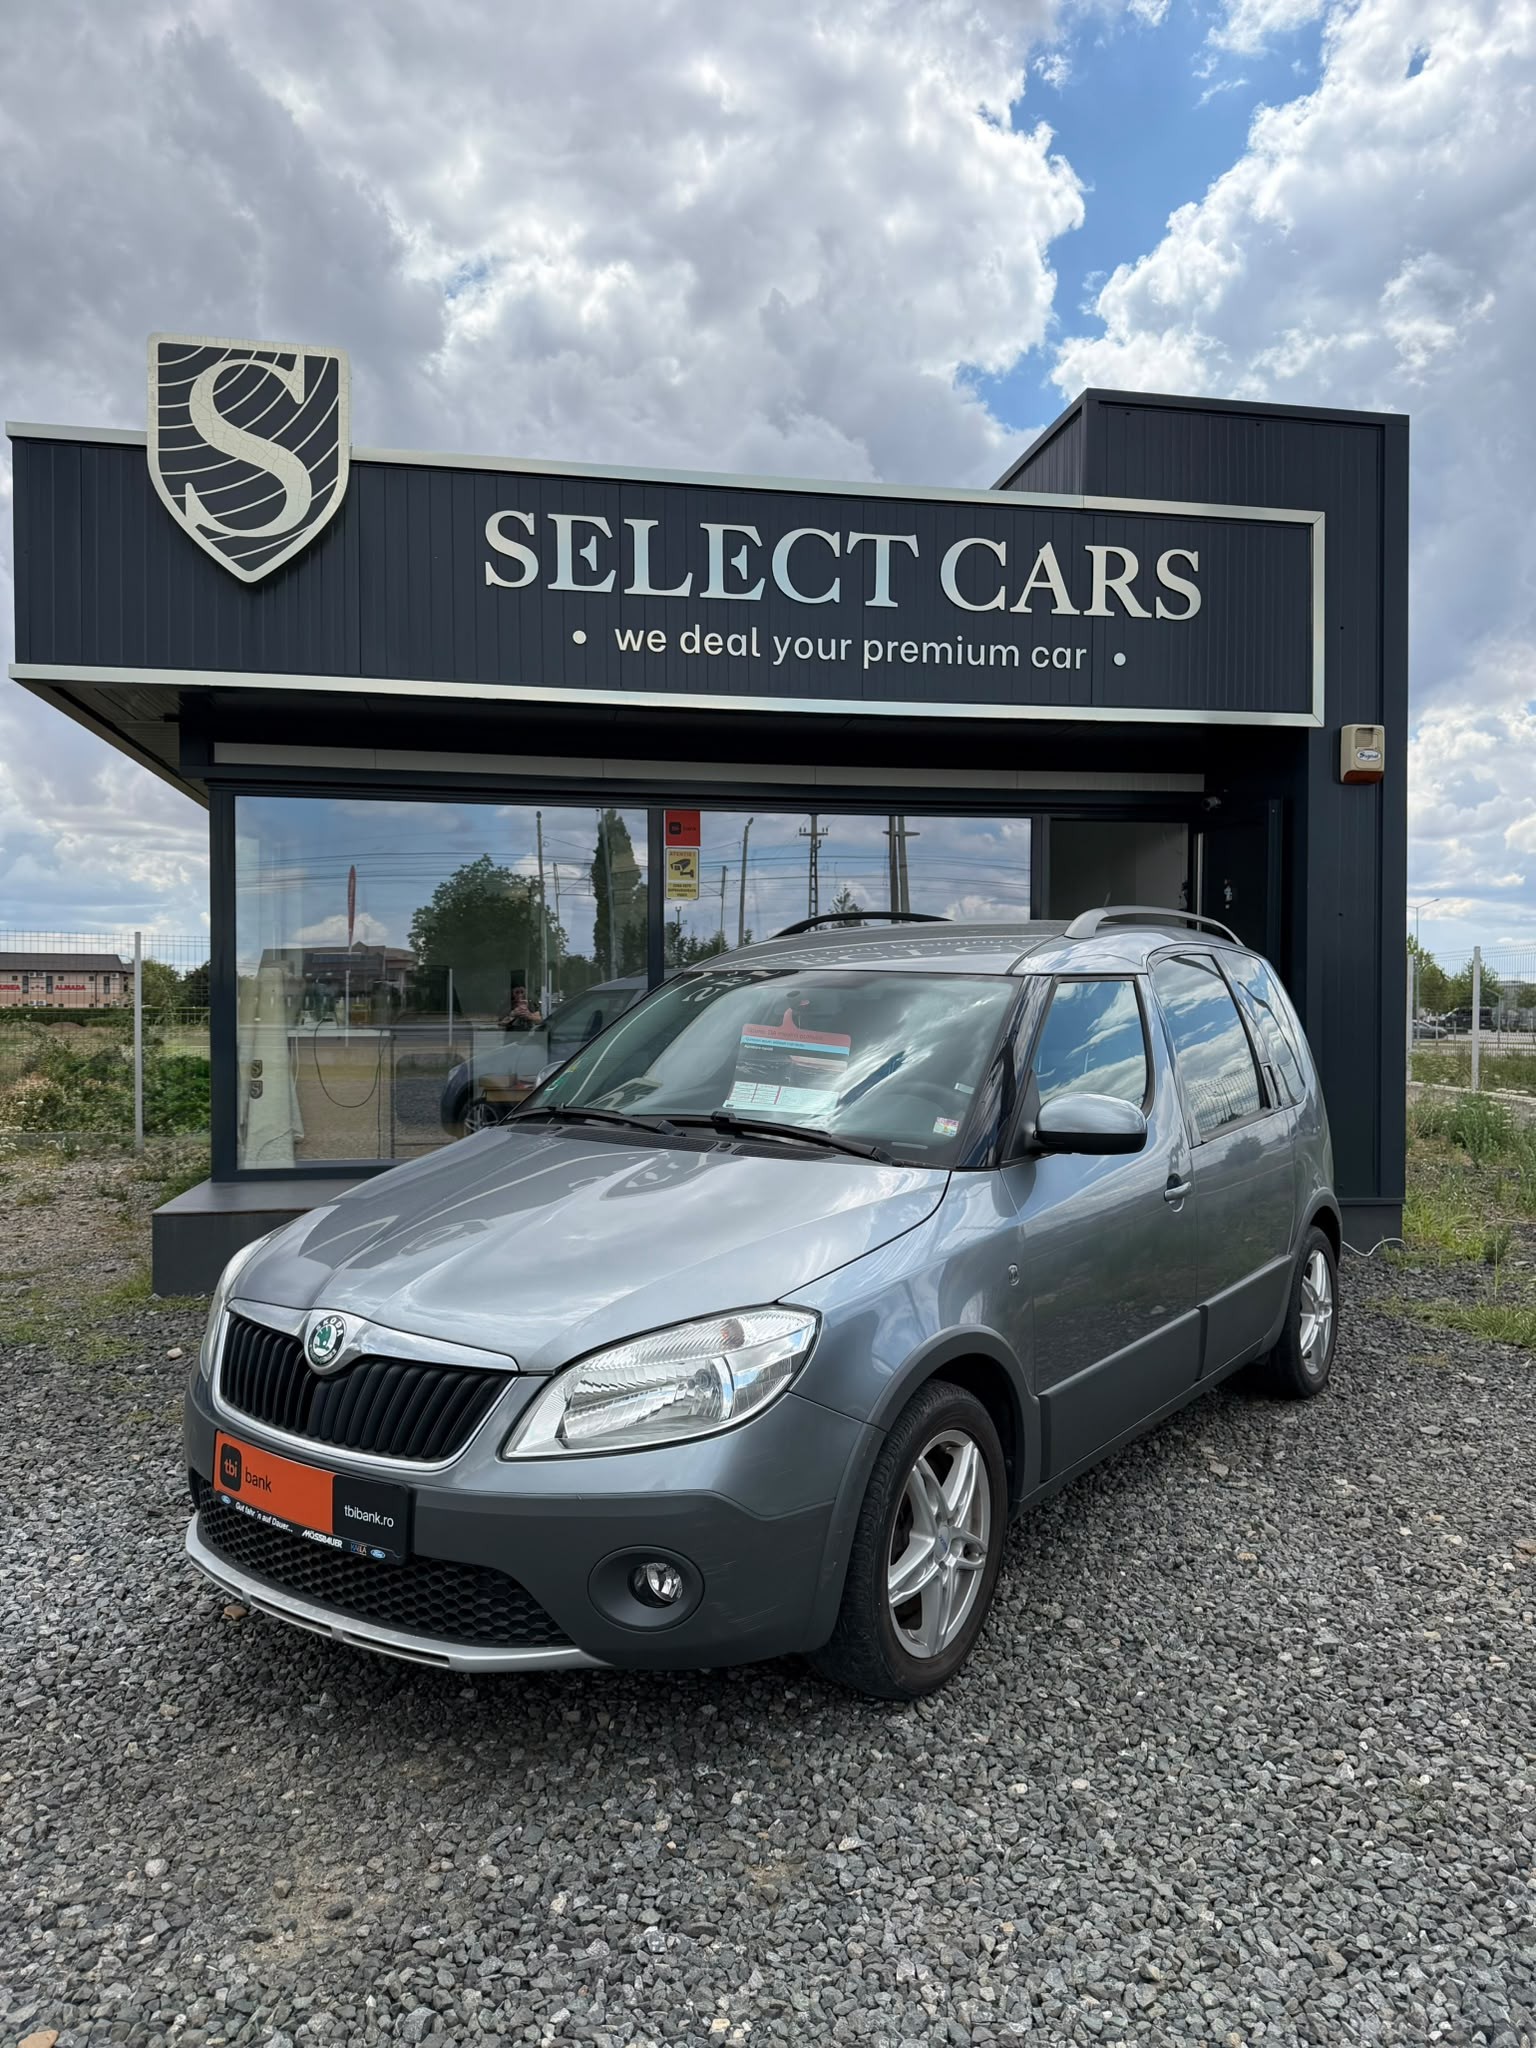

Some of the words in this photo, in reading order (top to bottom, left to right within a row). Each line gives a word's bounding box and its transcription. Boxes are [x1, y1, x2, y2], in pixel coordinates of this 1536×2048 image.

[185, 353, 312, 539] S
[484, 509, 920, 608] SELECT
[940, 537, 1202, 621] CARS
[614, 628, 667, 653] we
[679, 624, 761, 658] deal
[772, 635, 852, 666] your
[863, 635, 1020, 669] premium
[1031, 646, 1087, 670] car
[224, 1458, 238, 1478] tbi
[245, 1466, 272, 1493] bank
[344, 1505, 394, 1528] tbibank.ro
